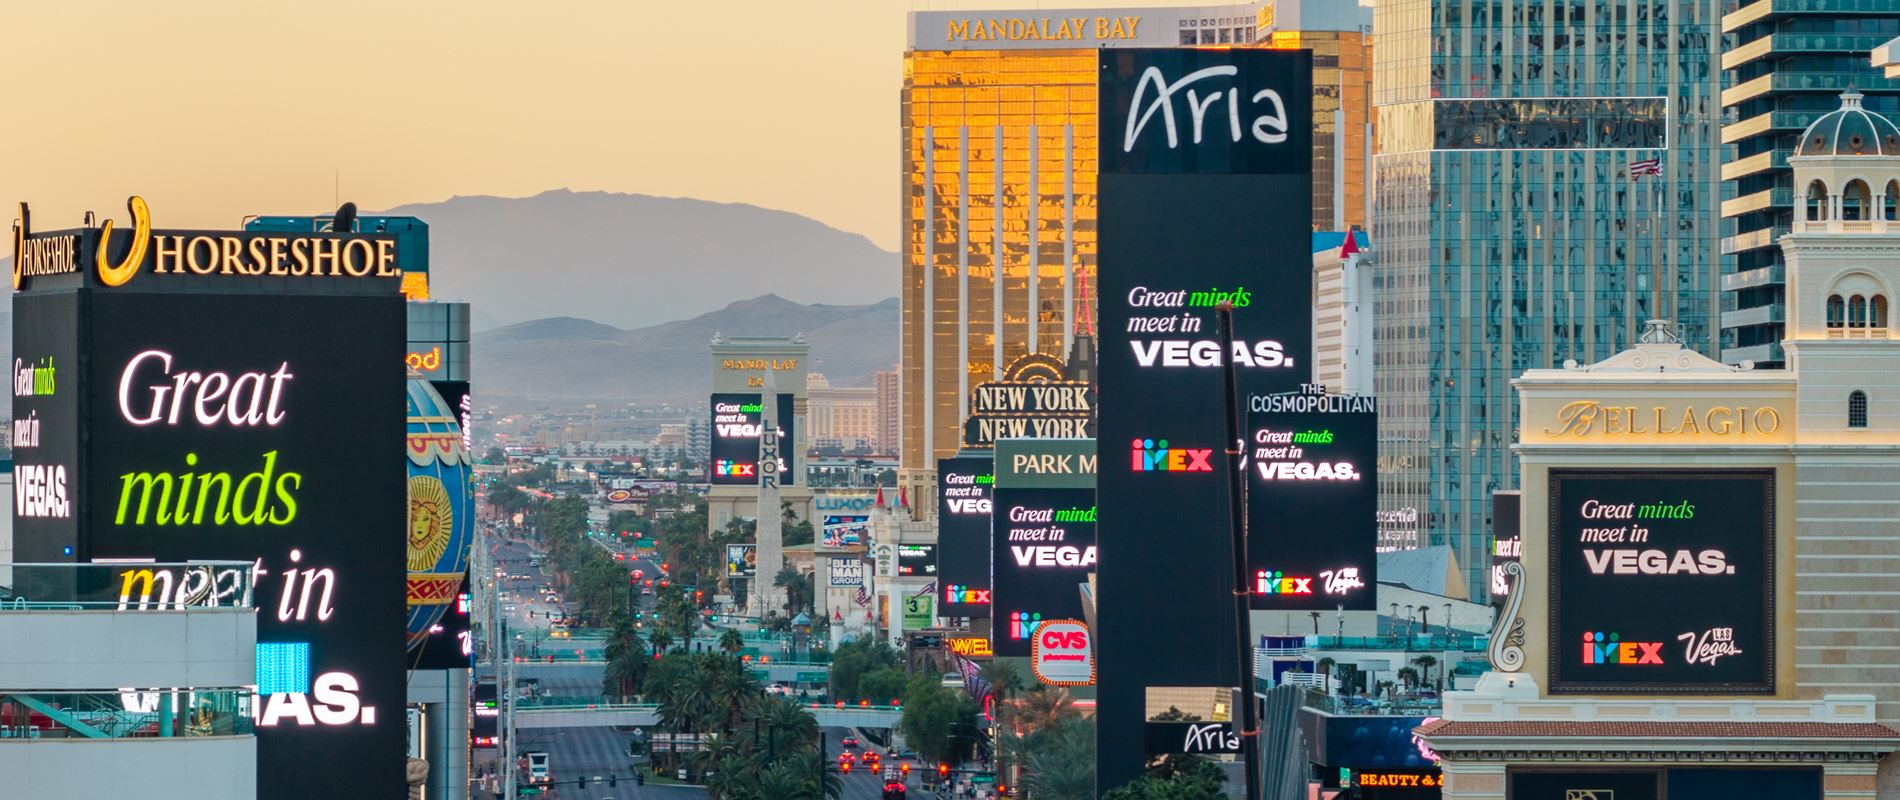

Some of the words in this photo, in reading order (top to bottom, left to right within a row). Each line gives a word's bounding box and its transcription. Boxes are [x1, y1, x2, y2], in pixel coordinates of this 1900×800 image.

[946, 18, 1088, 41] MANDALAY
[1095, 16, 1141, 40] BAY
[1123, 65, 1288, 153] Aria
[23, 236, 76, 276] HORSESHOE
[1127, 286, 1187, 307] Great
[1127, 314, 1178, 333] meet
[1180, 312, 1201, 333] in
[405, 346, 440, 371] od
[1129, 340, 1294, 367] VEGAS.
[722, 359, 798, 370] MANDLAY
[14, 357, 34, 396] Great
[118, 350, 293, 427] Great
[978, 386, 1027, 410] NEW
[1032, 386, 1090, 410] YORK
[1300, 384, 1325, 394] THE
[715, 402, 741, 413] Great
[740, 403, 763, 413] mind
[1250, 395, 1374, 413] COSMOPOLITAN
[715, 414, 738, 423] meet
[738, 413, 747, 423] in
[1544, 400, 1780, 436] BELLAGIO
[14, 413, 31, 448] meet
[31, 409, 40, 448] in
[978, 418, 1027, 442] NEW
[1032, 418, 1089, 439] YORK
[1256, 429, 1294, 444] Great
[1293, 430, 1334, 444] minds
[761, 419, 778, 490] LUXOR
[1255, 446, 1288, 458] meet
[1289, 446, 1302, 458] in
[1013, 454, 1073, 474] PARK
[1257, 462, 1360, 480] VEGAS.
[115, 450, 301, 526] minds
[945, 473, 978, 484] Great
[976, 474, 995, 484] min
[14, 464, 70, 518] VEGAS.
[945, 487, 971, 496] meet
[971, 486, 983, 496] in
[946, 499, 992, 513] VEG
[1009, 505, 1054, 522] Great
[1581, 499, 1635, 519] Great
[1638, 500, 1695, 519] minds
[1008, 527, 1048, 541] meet
[1048, 525, 1065, 541] in
[1580, 526, 1628, 543] meet
[1630, 524, 1648, 543] in
[832, 559, 862, 568] BLUE
[1011, 545, 1097, 567] VEGA
[1583, 549, 1736, 575] VEGAS.
[832, 568, 863, 577] MAN
[277, 549, 336, 622] in
[1042, 630, 1086, 650] CVS
[1714, 629, 1731, 640] LAS
[950, 638, 993, 655] WEL
[1677, 629, 1743, 666] Vegas
[1184, 723, 1240, 752] Aria
[1360, 773, 1419, 786] BEAUTY
[1421, 775, 1435, 786] &
